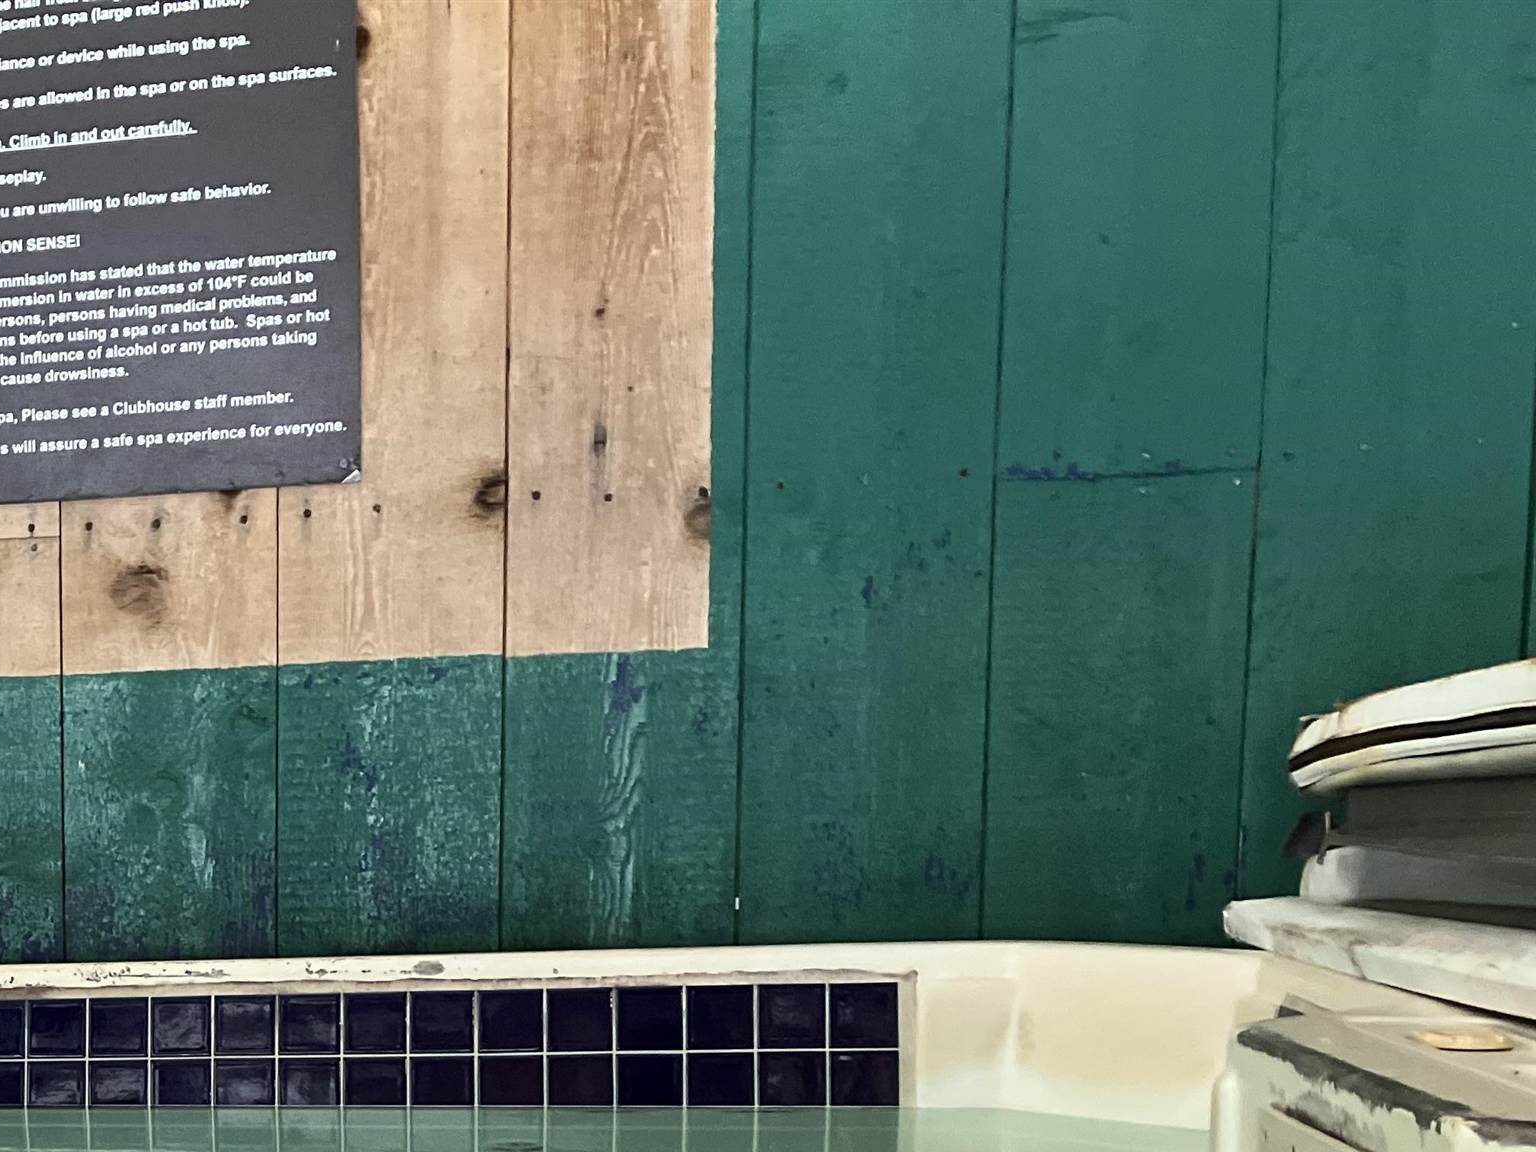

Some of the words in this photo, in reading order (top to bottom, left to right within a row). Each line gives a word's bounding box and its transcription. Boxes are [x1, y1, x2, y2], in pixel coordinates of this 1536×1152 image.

[37, 54, 55, 67] or
[56, 48, 104, 65] device
[106, 43, 146, 60] while
[148, 39, 190, 56] using
[191, 36, 217, 51] the
[218, 34, 251, 51] spa.
[11, 95, 36, 109] are
[38, 87, 94, 106] allowed
[96, 86, 111, 100] in
[113, 84, 137, 99] the
[139, 82, 167, 98] spa
[169, 80, 187, 93] or
[188, 78, 209, 91] on
[210, 74, 236, 89] the
[237, 72, 266, 89] spa
[268, 65, 338, 83] surfaces.
[12, 204, 36, 218] are
[38, 197, 103, 215] unwilling
[104, 195, 121, 209] to
[122, 191, 168, 207] follow
[170, 187, 202, 203] safe
[204, 182, 272, 200] behavior.
[69, 268, 97, 283] has
[98, 263, 145, 281] stated
[146, 261, 176, 277] that
[177, 259, 202, 274] the
[204, 256, 246, 271] water
[247, 249, 337, 269] temperature
[58, 289, 72, 304] in
[74, 287, 116, 302] water
[117, 284, 132, 299] in
[133, 282, 185, 298] excess
[187, 277, 205, 293] of
[249, 270, 292, 288] could
[294, 270, 314, 284] be
[19, 330, 65, 346] before
[67, 326, 107, 343] using
[109, 327, 120, 339] a
[122, 324, 149, 341] spa
[151, 323, 169, 336] or
[170, 322, 180, 335] a
[182, 318, 208, 333] hot
[209, 315, 239, 331] tub.
[245, 313, 284, 331] Spas
[284, 312, 304, 325] or
[305, 308, 331, 324] hot
[20, 350, 85, 366] influence
[86, 345, 103, 361] of
[104, 341, 158, 360] alcohol
[160, 342, 177, 355] or
[179, 340, 208, 356] any
[209, 335, 269, 354] persons
[271, 329, 318, 347] taking
[0, 372, 42, 386] cause
[44, 365, 130, 383] drowsiness.
[11, 439, 37, 455] will
[39, 438, 88, 453] assure
[90, 437, 100, 449] a
[103, 432, 134, 449] safe
[136, 433, 164, 449] spa
[166, 426, 247, 446] experience
[249, 423, 272, 438] for
[273, 420, 348, 438] everyone.
